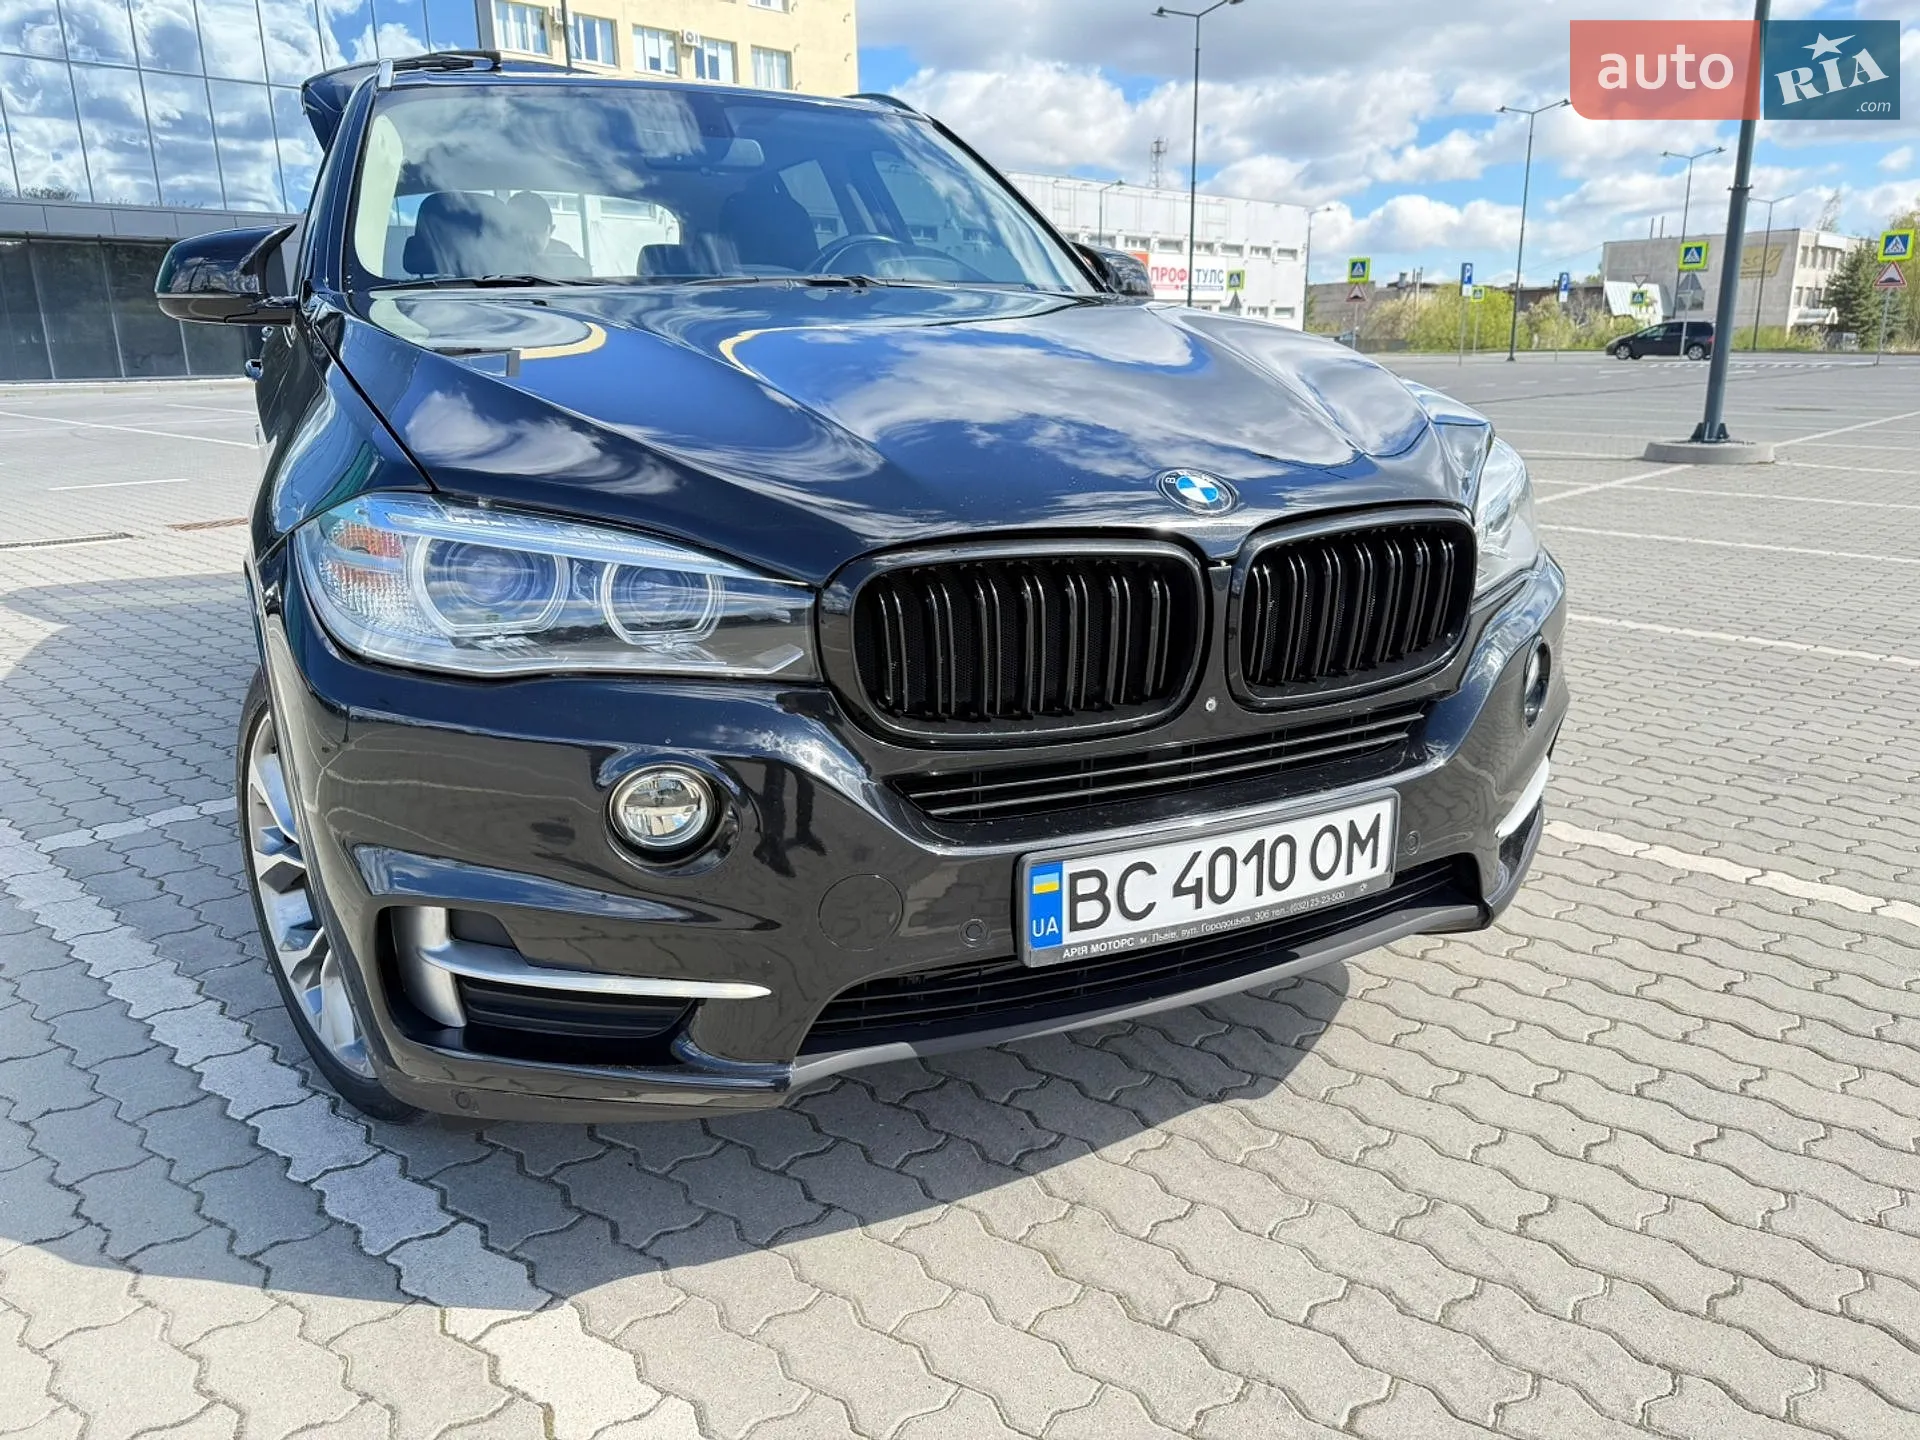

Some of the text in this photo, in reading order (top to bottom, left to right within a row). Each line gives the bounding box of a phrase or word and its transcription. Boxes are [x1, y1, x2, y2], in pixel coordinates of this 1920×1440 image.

[1195, 268, 1225, 284] ТУЛС
[1032, 813, 1381, 938] UA BC 4010 OM
[1090, 937, 1135, 954] МОТОРС
